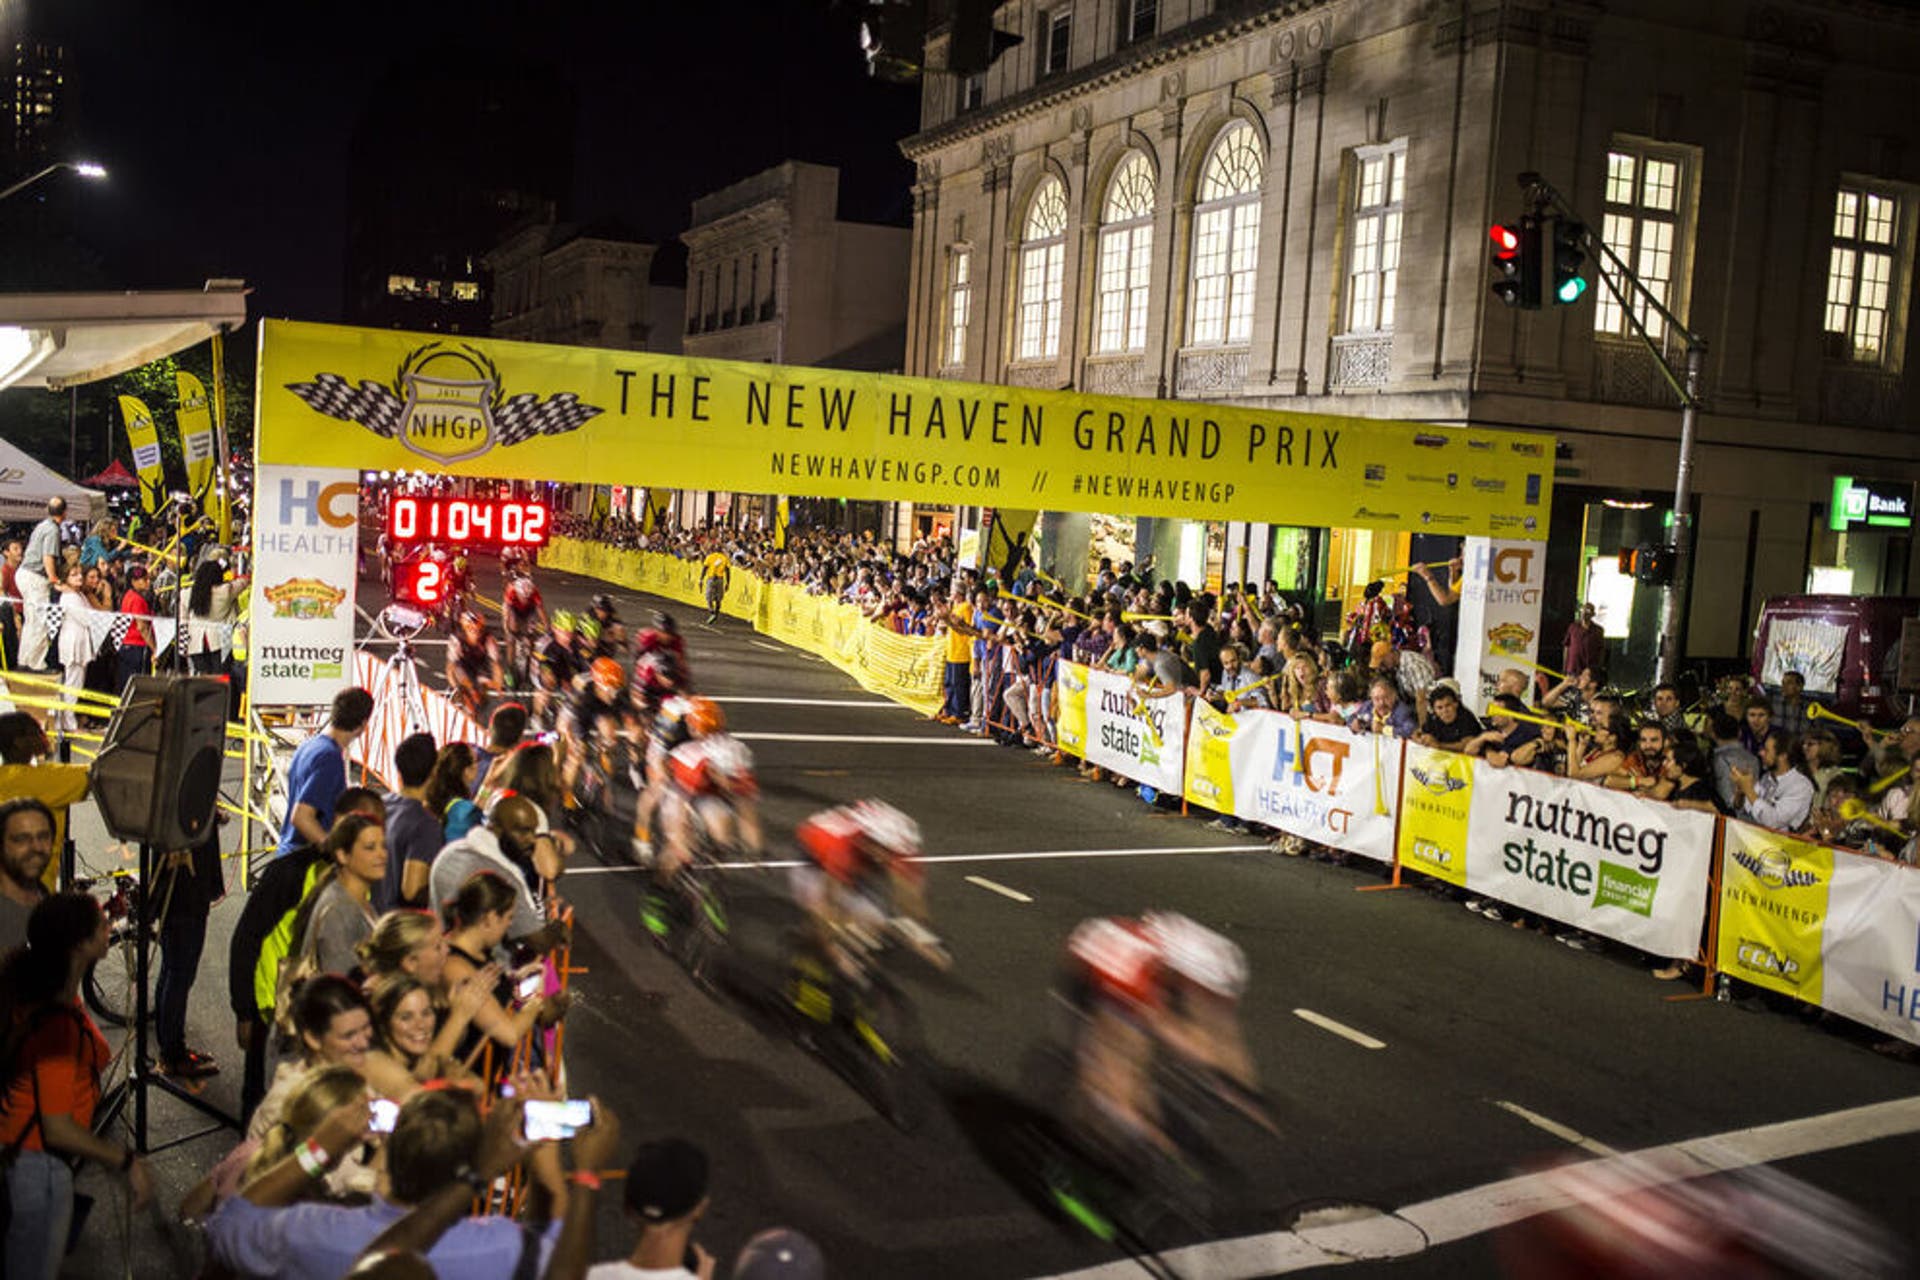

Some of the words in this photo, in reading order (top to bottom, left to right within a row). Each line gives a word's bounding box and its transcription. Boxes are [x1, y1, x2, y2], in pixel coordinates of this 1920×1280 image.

[412, 413, 482, 440] NHGP
[615, 369, 711, 422] THE
[747, 381, 856, 432] NEW
[889, 393, 1043, 447] HAVEN
[1074, 409, 1222, 460] GRAND
[1249, 424, 1340, 469] PRIX
[771, 452, 1000, 489] NEWHAVENGP.COM
[1073, 475, 1235, 503] #NEWHAVENGP
[1868, 494, 1907, 513] Bank
[260, 532, 354, 554] HEALTH
[416, 561, 440, 601] 2
[1473, 544, 1535, 584] HCT
[261, 662, 310, 678] state
[262, 645, 344, 664] nutmeg
[1101, 720, 1139, 757] state
[1272, 728, 1350, 796] HCT
[1504, 790, 1668, 874] nutmeg
[1503, 837, 1593, 896] state
